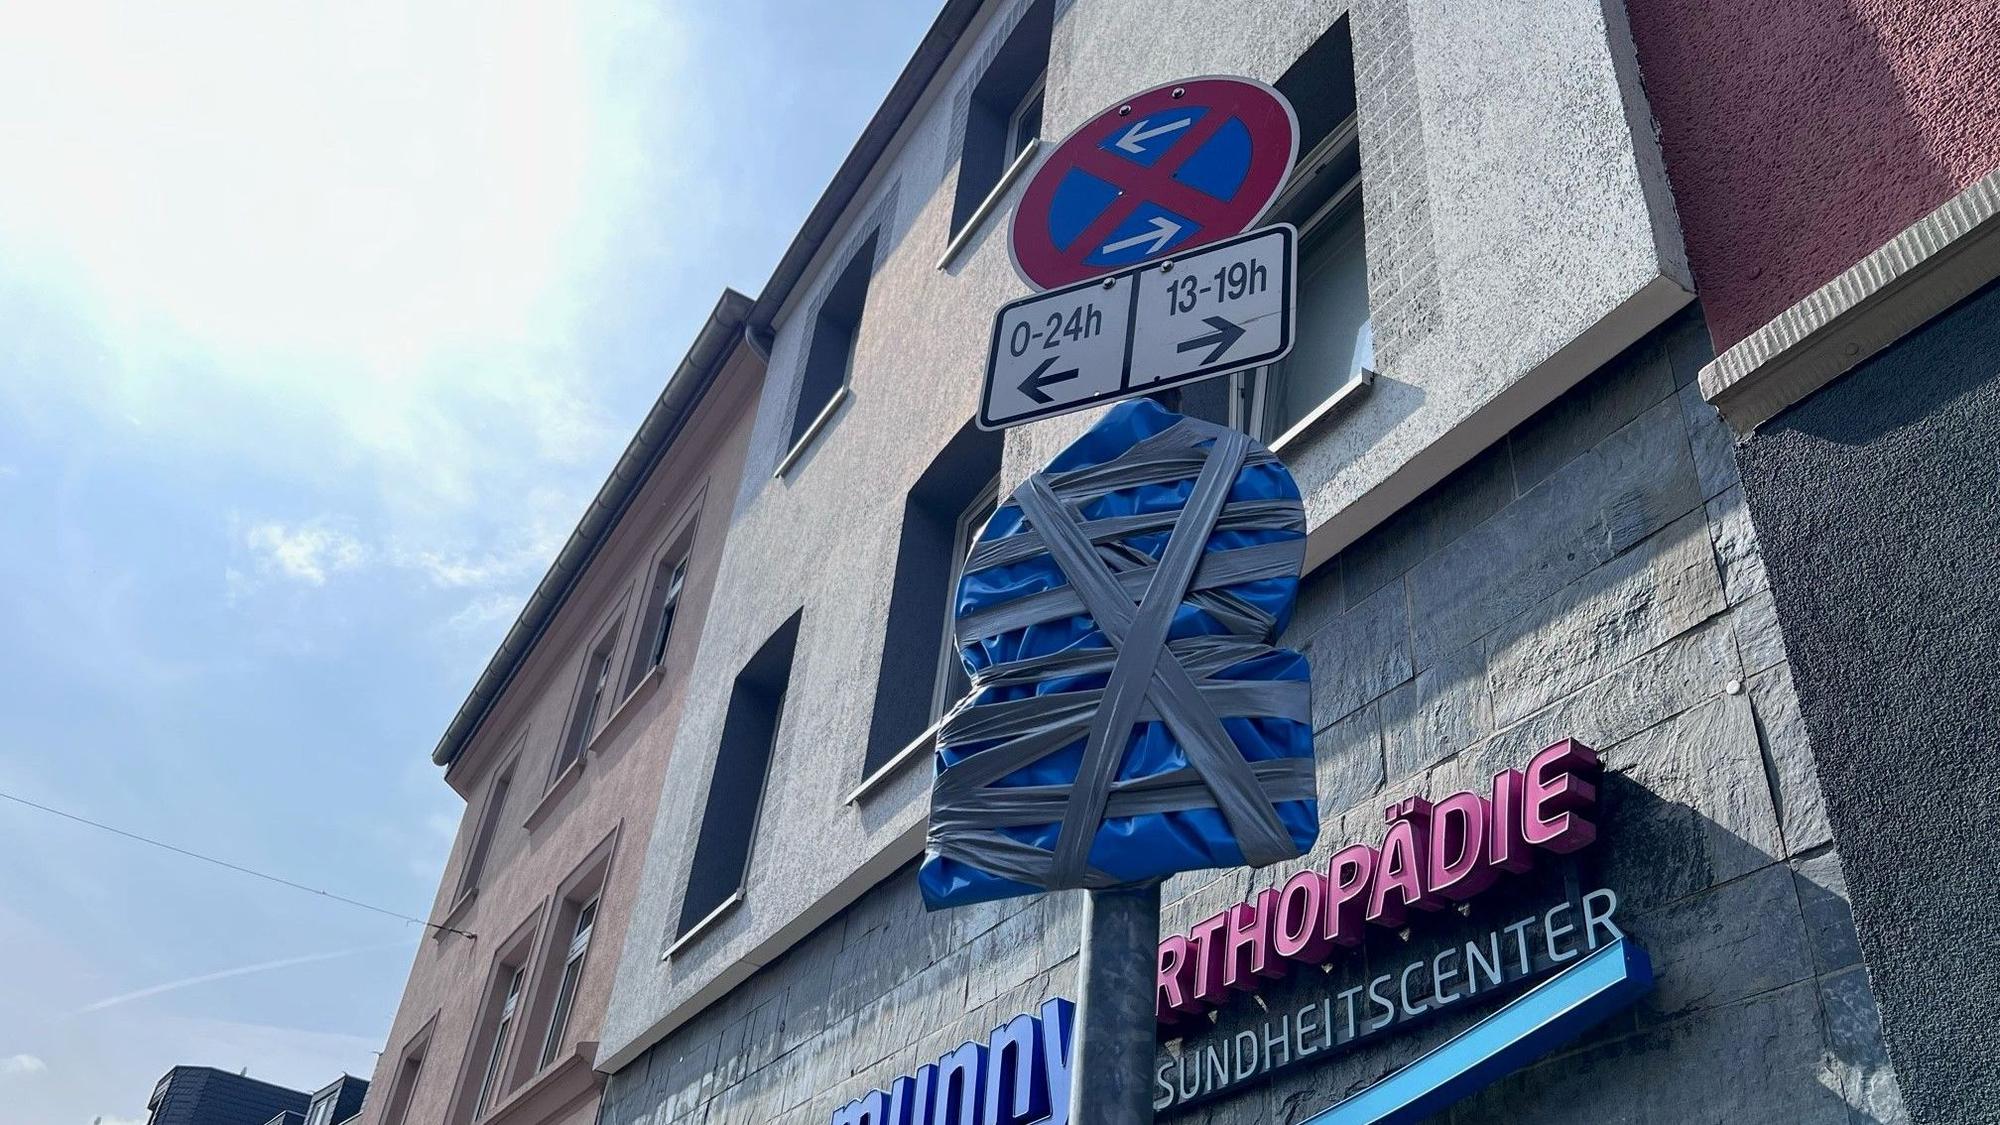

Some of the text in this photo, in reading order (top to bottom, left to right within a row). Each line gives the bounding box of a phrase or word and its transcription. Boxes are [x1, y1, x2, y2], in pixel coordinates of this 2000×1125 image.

[1011, 304, 1102, 357] 0-24h
[1167, 258, 1267, 316] 13-19h
[1153, 888, 1624, 1111] SUNDHEITSCENTER
[832, 997, 1077, 1125] nny
